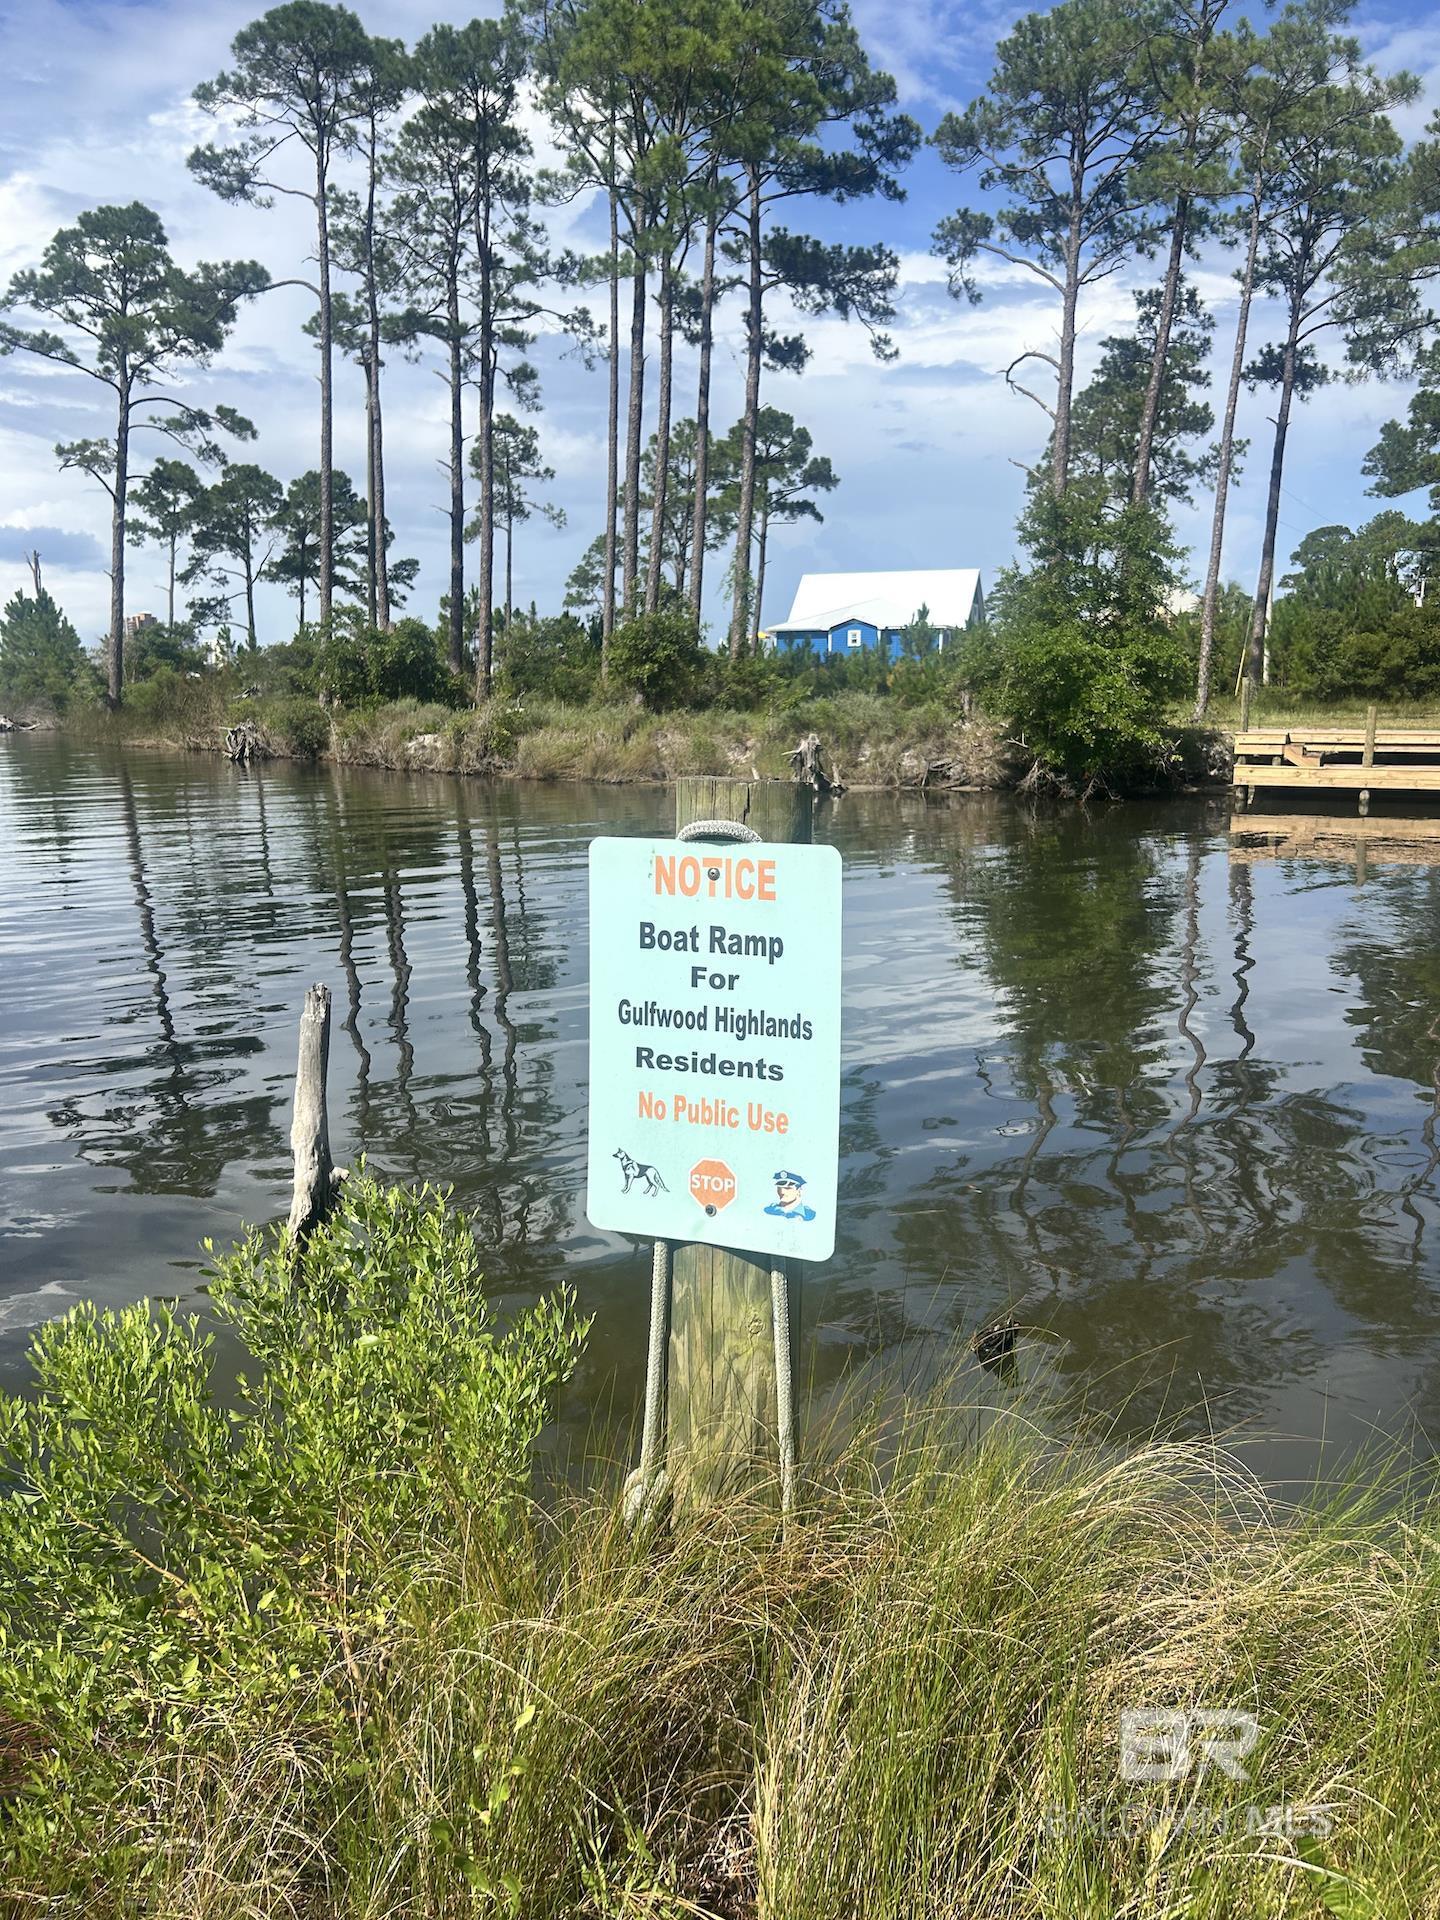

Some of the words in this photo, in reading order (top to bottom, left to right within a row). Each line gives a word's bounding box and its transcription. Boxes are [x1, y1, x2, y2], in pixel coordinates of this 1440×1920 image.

[655, 855, 777, 901] NOTICE
[639, 921, 700, 953] Boat
[709, 925, 784, 964] Ramp
[690, 966, 740, 991] For
[618, 999, 708, 1031] Gulfwood
[714, 1005, 813, 1041] Highlands
[635, 1046, 784, 1081] Residents
[638, 1091, 667, 1121] No
[674, 1095, 740, 1129] Public
[747, 1103, 789, 1135] Use
[690, 1174, 734, 1193] STOP
